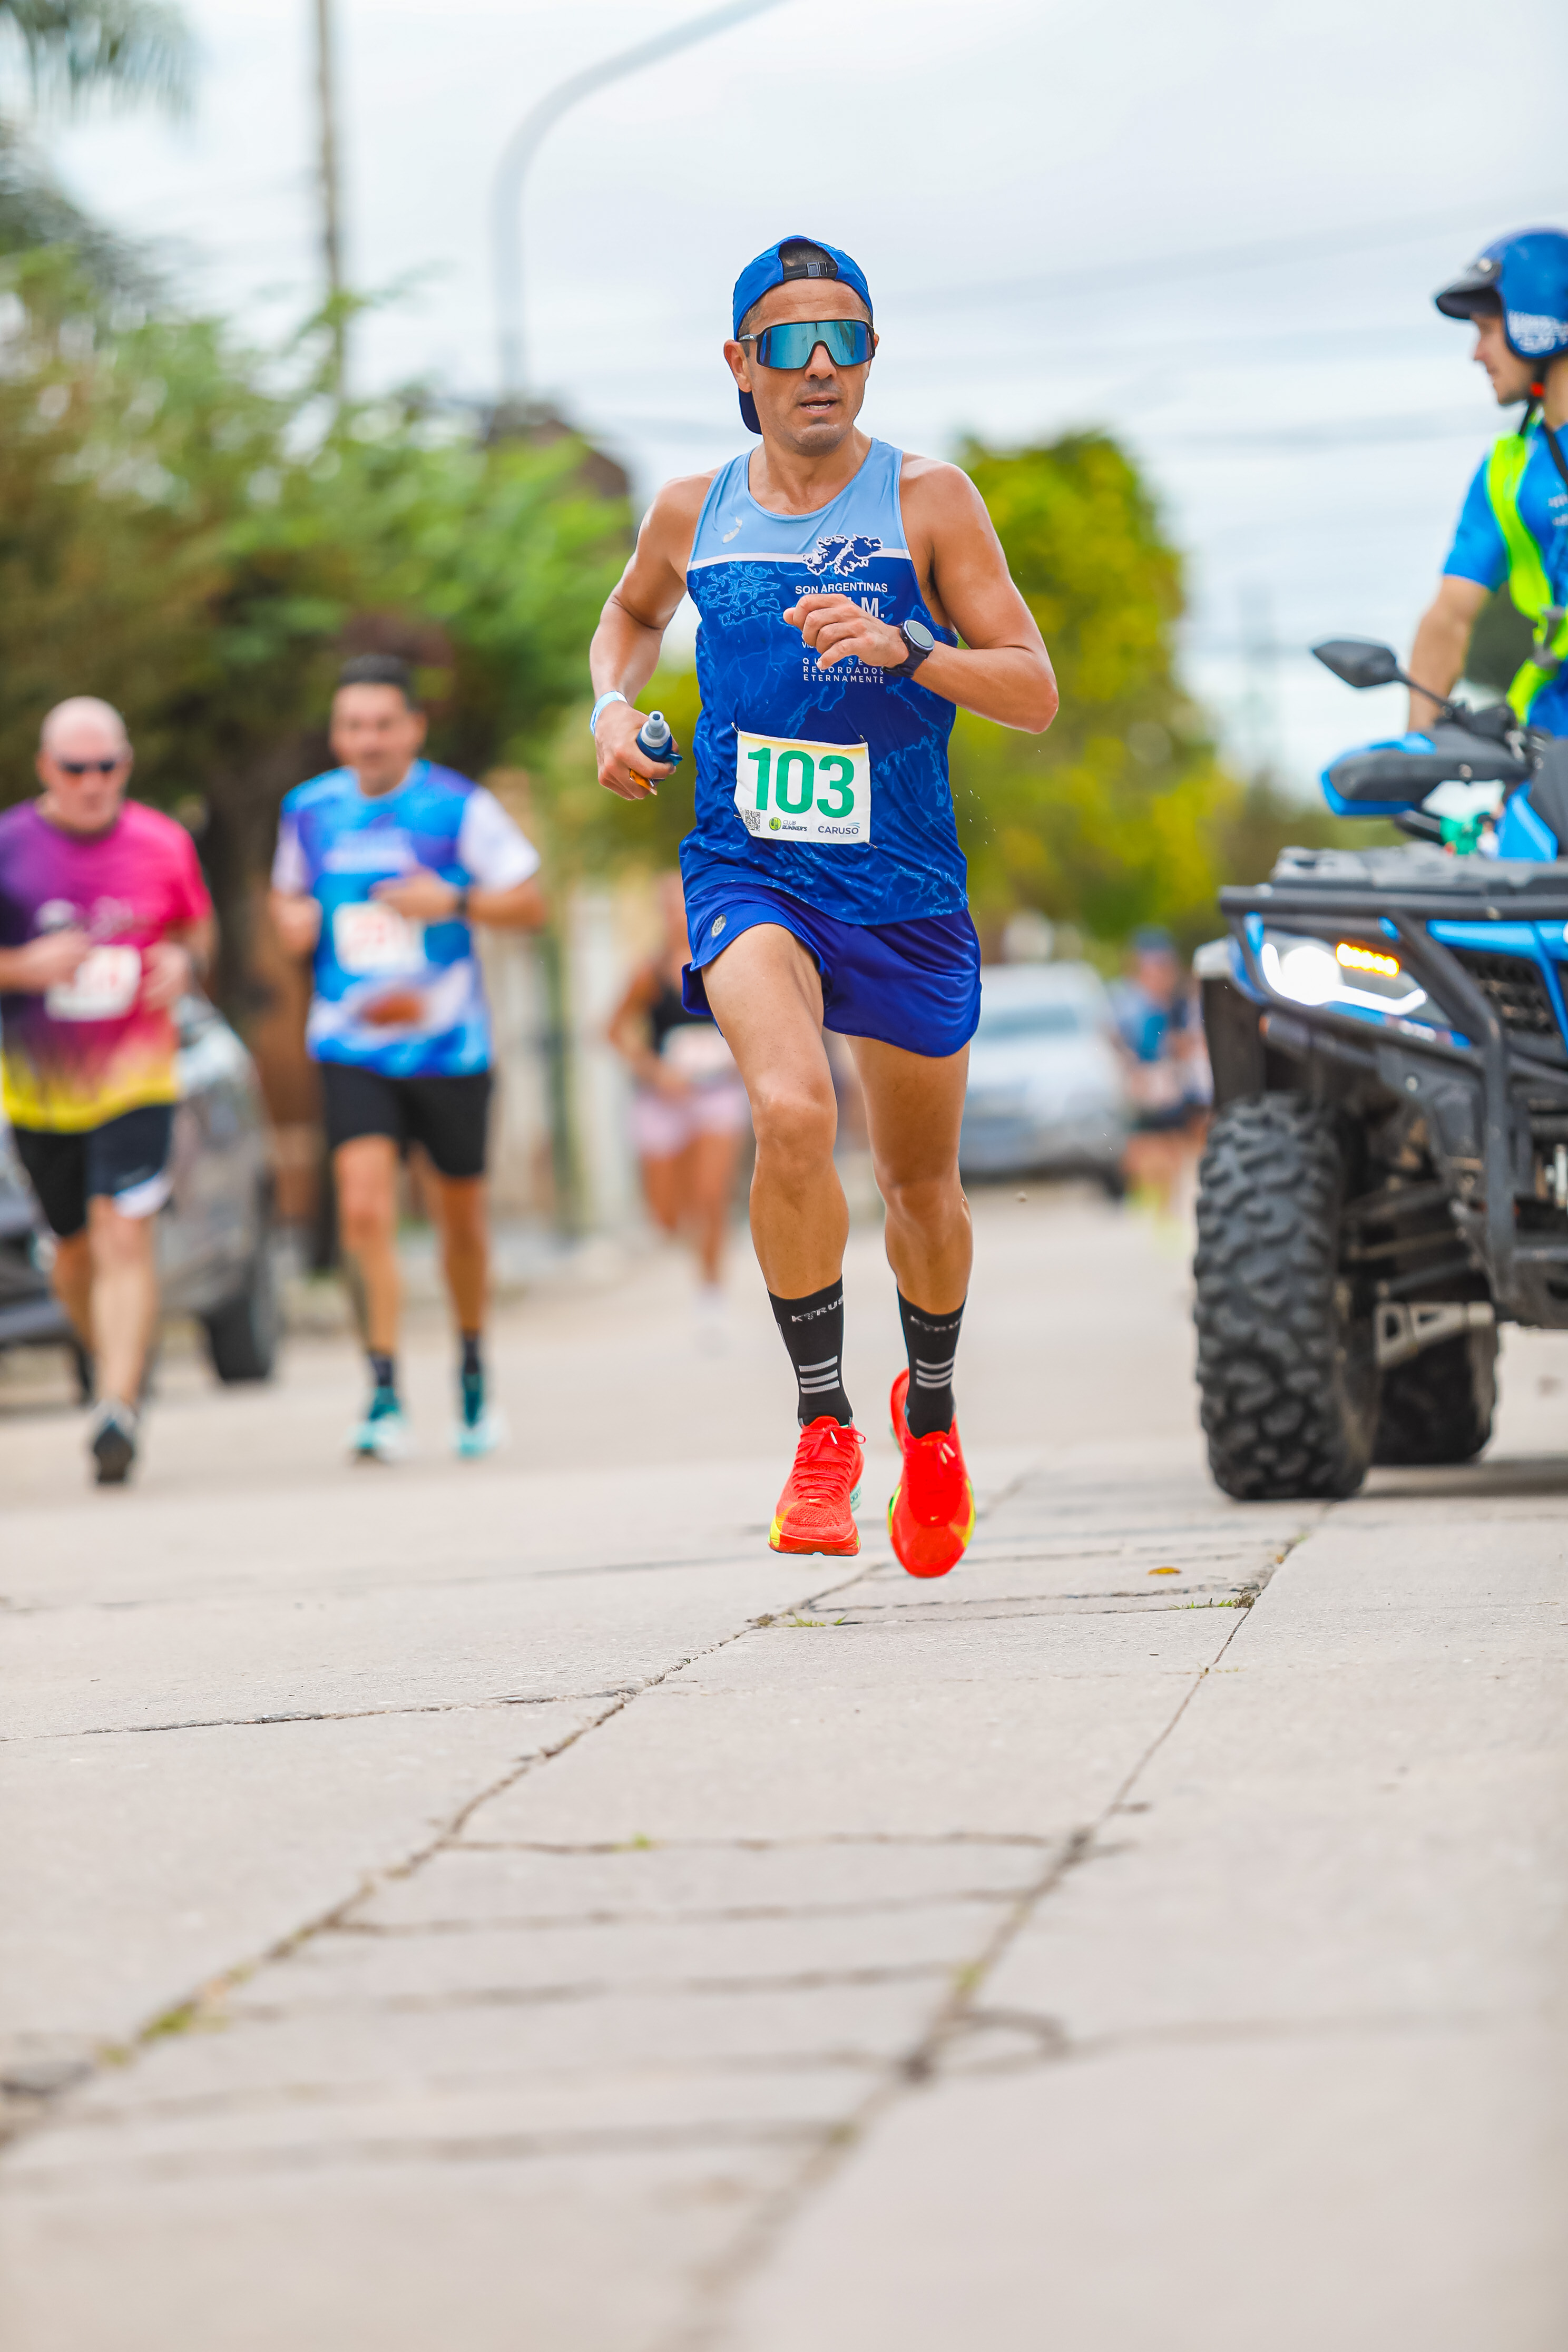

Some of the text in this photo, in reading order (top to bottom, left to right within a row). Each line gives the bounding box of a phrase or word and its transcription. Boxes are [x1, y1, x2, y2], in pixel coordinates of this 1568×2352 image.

[795, 582, 888, 594] SON ARGENTINAS
[803, 674, 884, 683] ETERNAMENTE
[748, 747, 855, 818] 103
[818, 826, 859, 834] CARUSO
